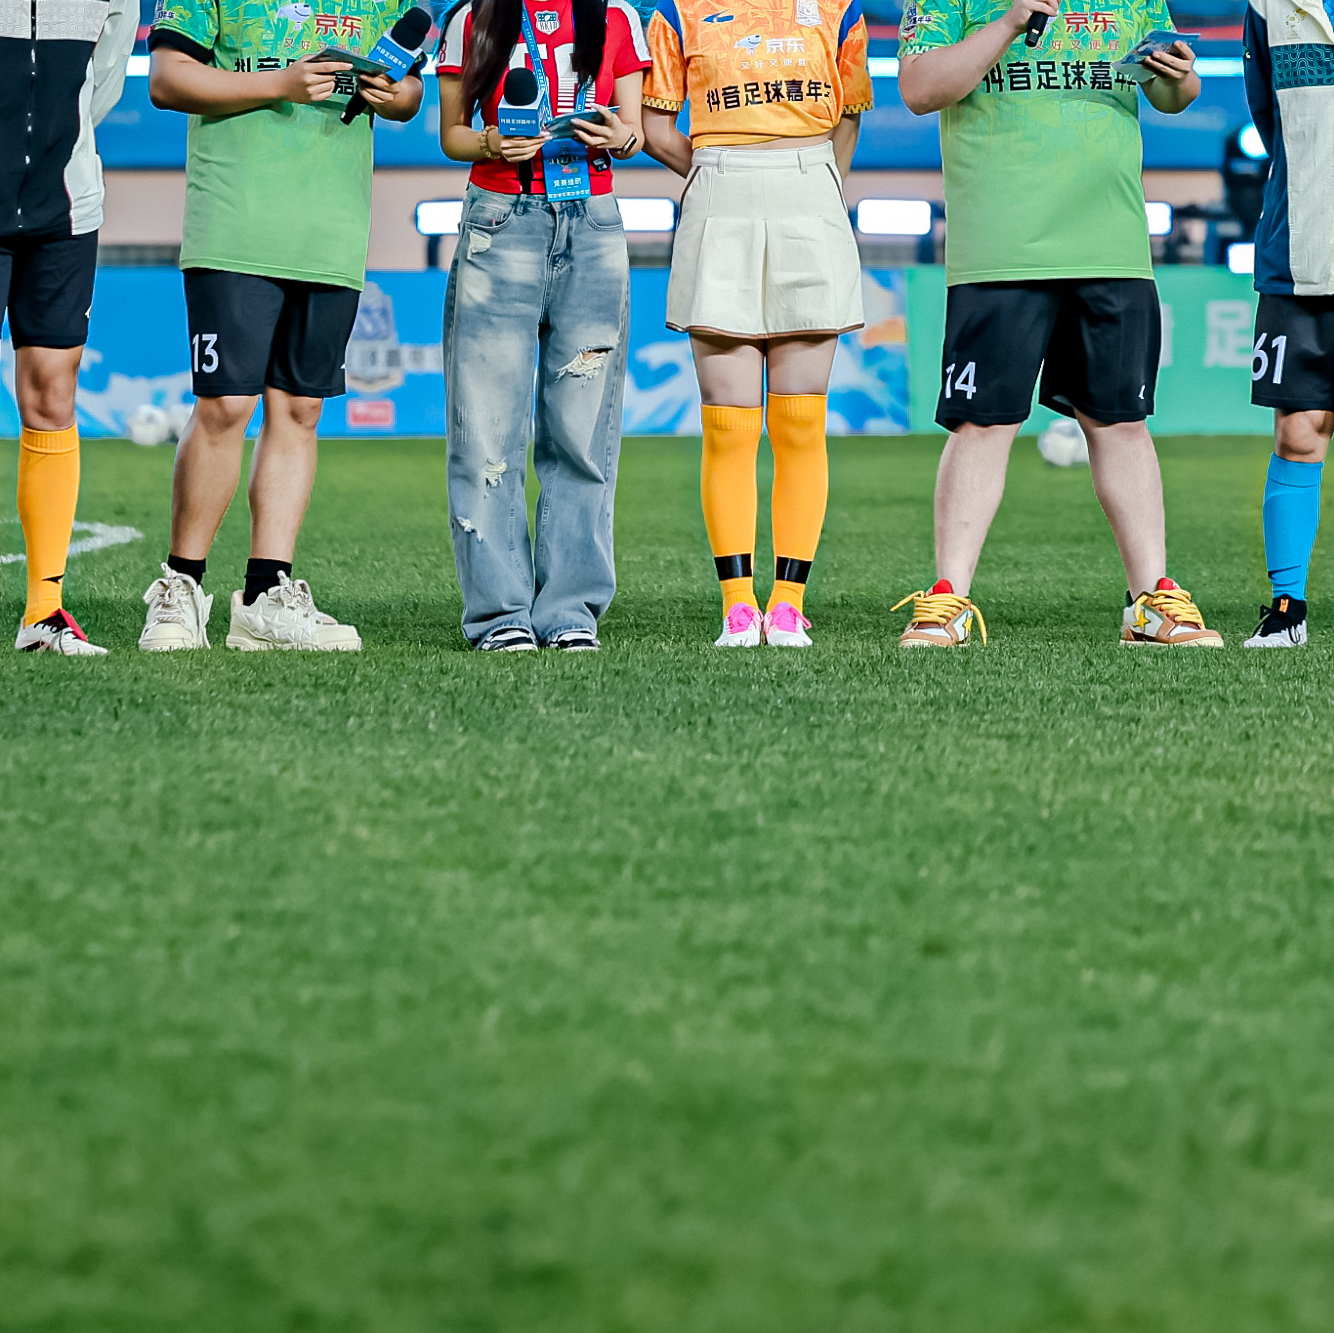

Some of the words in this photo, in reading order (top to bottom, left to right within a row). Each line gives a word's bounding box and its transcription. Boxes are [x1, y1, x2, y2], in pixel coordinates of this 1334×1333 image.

[315, 13, 362, 39] 京东
[1063, 11, 1118, 33] 京东
[765, 37, 805, 54] 京东
[192, 333, 219, 373] 13
[1252, 332, 1287, 384] 61
[945, 361, 977, 400] 14
